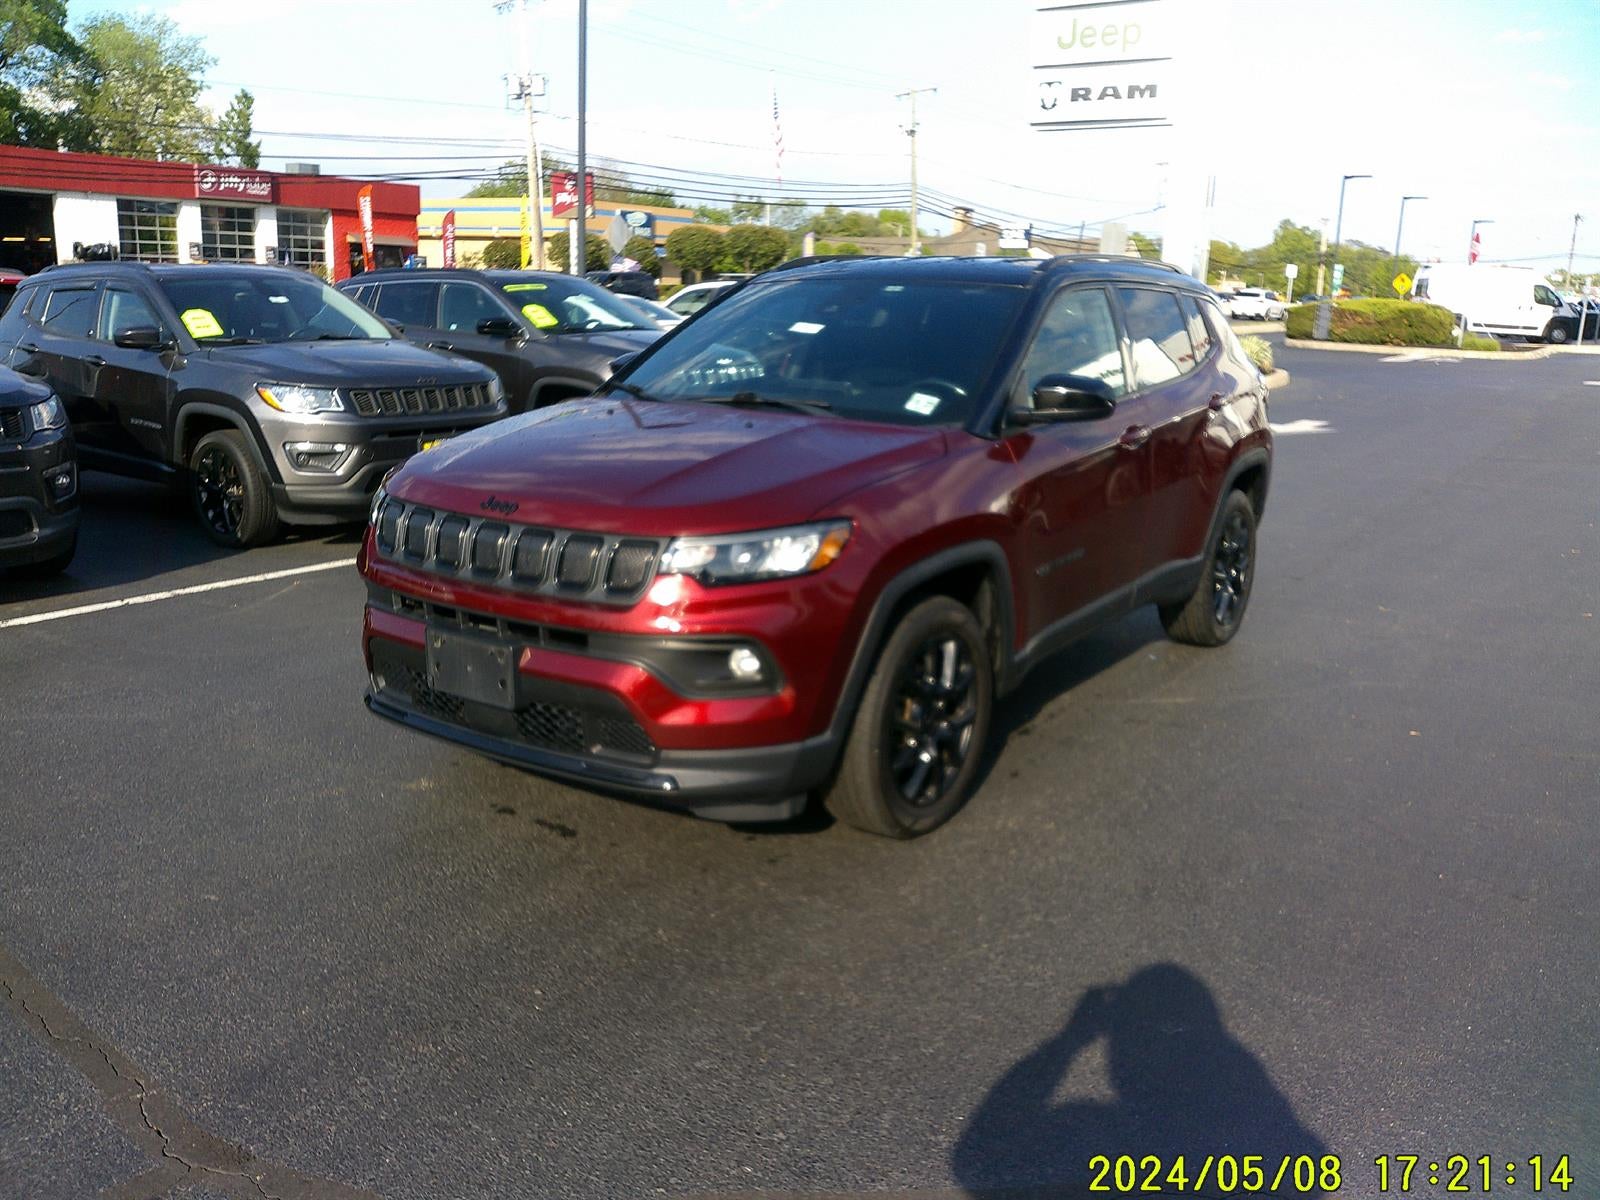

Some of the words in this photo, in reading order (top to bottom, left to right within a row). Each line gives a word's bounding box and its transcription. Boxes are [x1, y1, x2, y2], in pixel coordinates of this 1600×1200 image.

[1057, 18, 1142, 52] Jeep
[1070, 84, 1158, 102] RAM
[480, 495, 519, 516] Jeep
